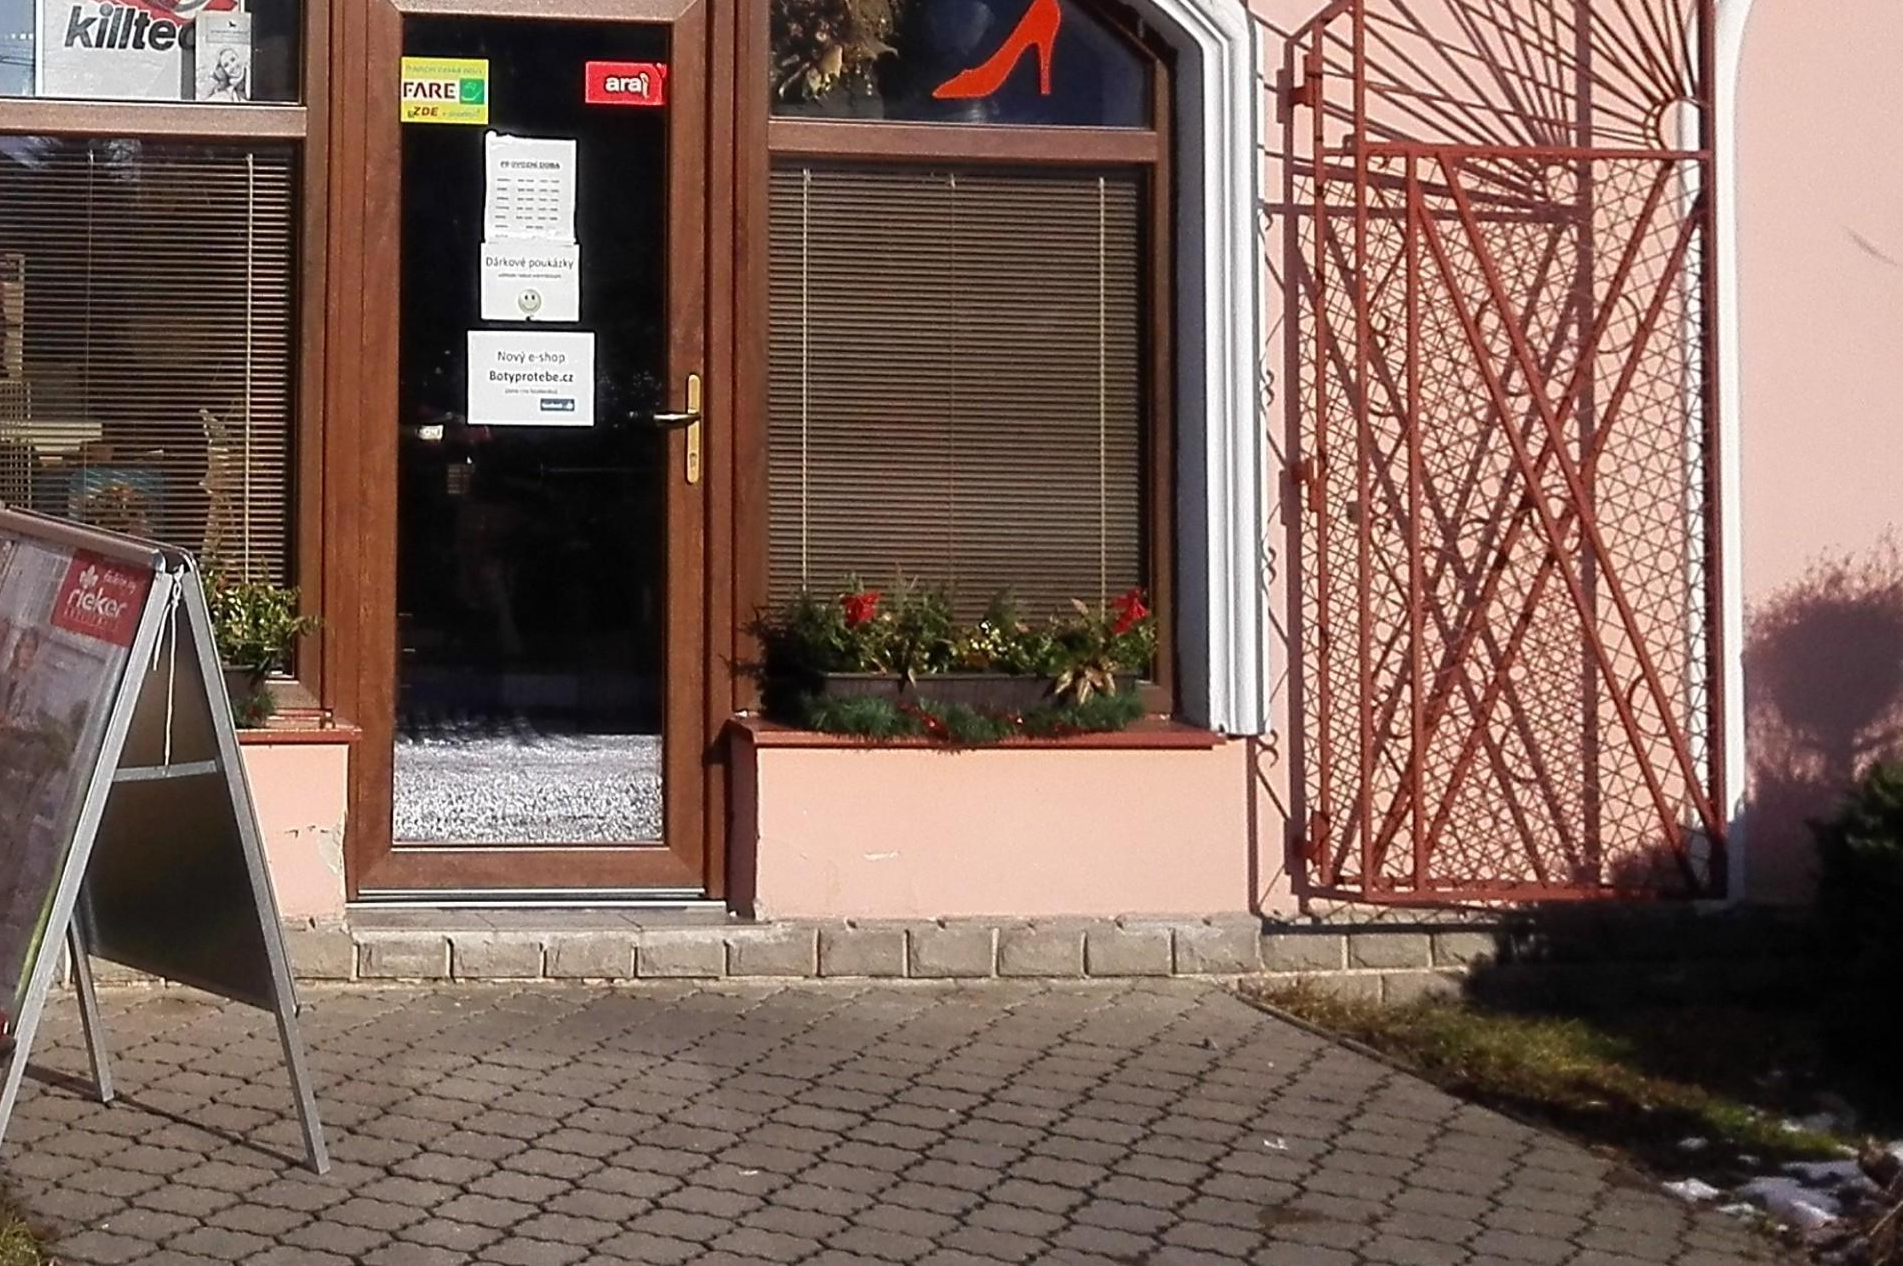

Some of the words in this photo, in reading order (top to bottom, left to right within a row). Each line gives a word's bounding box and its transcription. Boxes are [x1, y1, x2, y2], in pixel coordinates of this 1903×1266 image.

[403, 81, 456, 99] FARE
[413, 106, 439, 117] ZDE
[486, 256, 526, 268] Dárkové
[528, 258, 574, 270] poukázky
[497, 350, 525, 364] Nový
[528, 352, 566, 364] e-shop
[489, 370, 574, 384] Botyprotebe.cz
[65, 587, 127, 618] rieker
